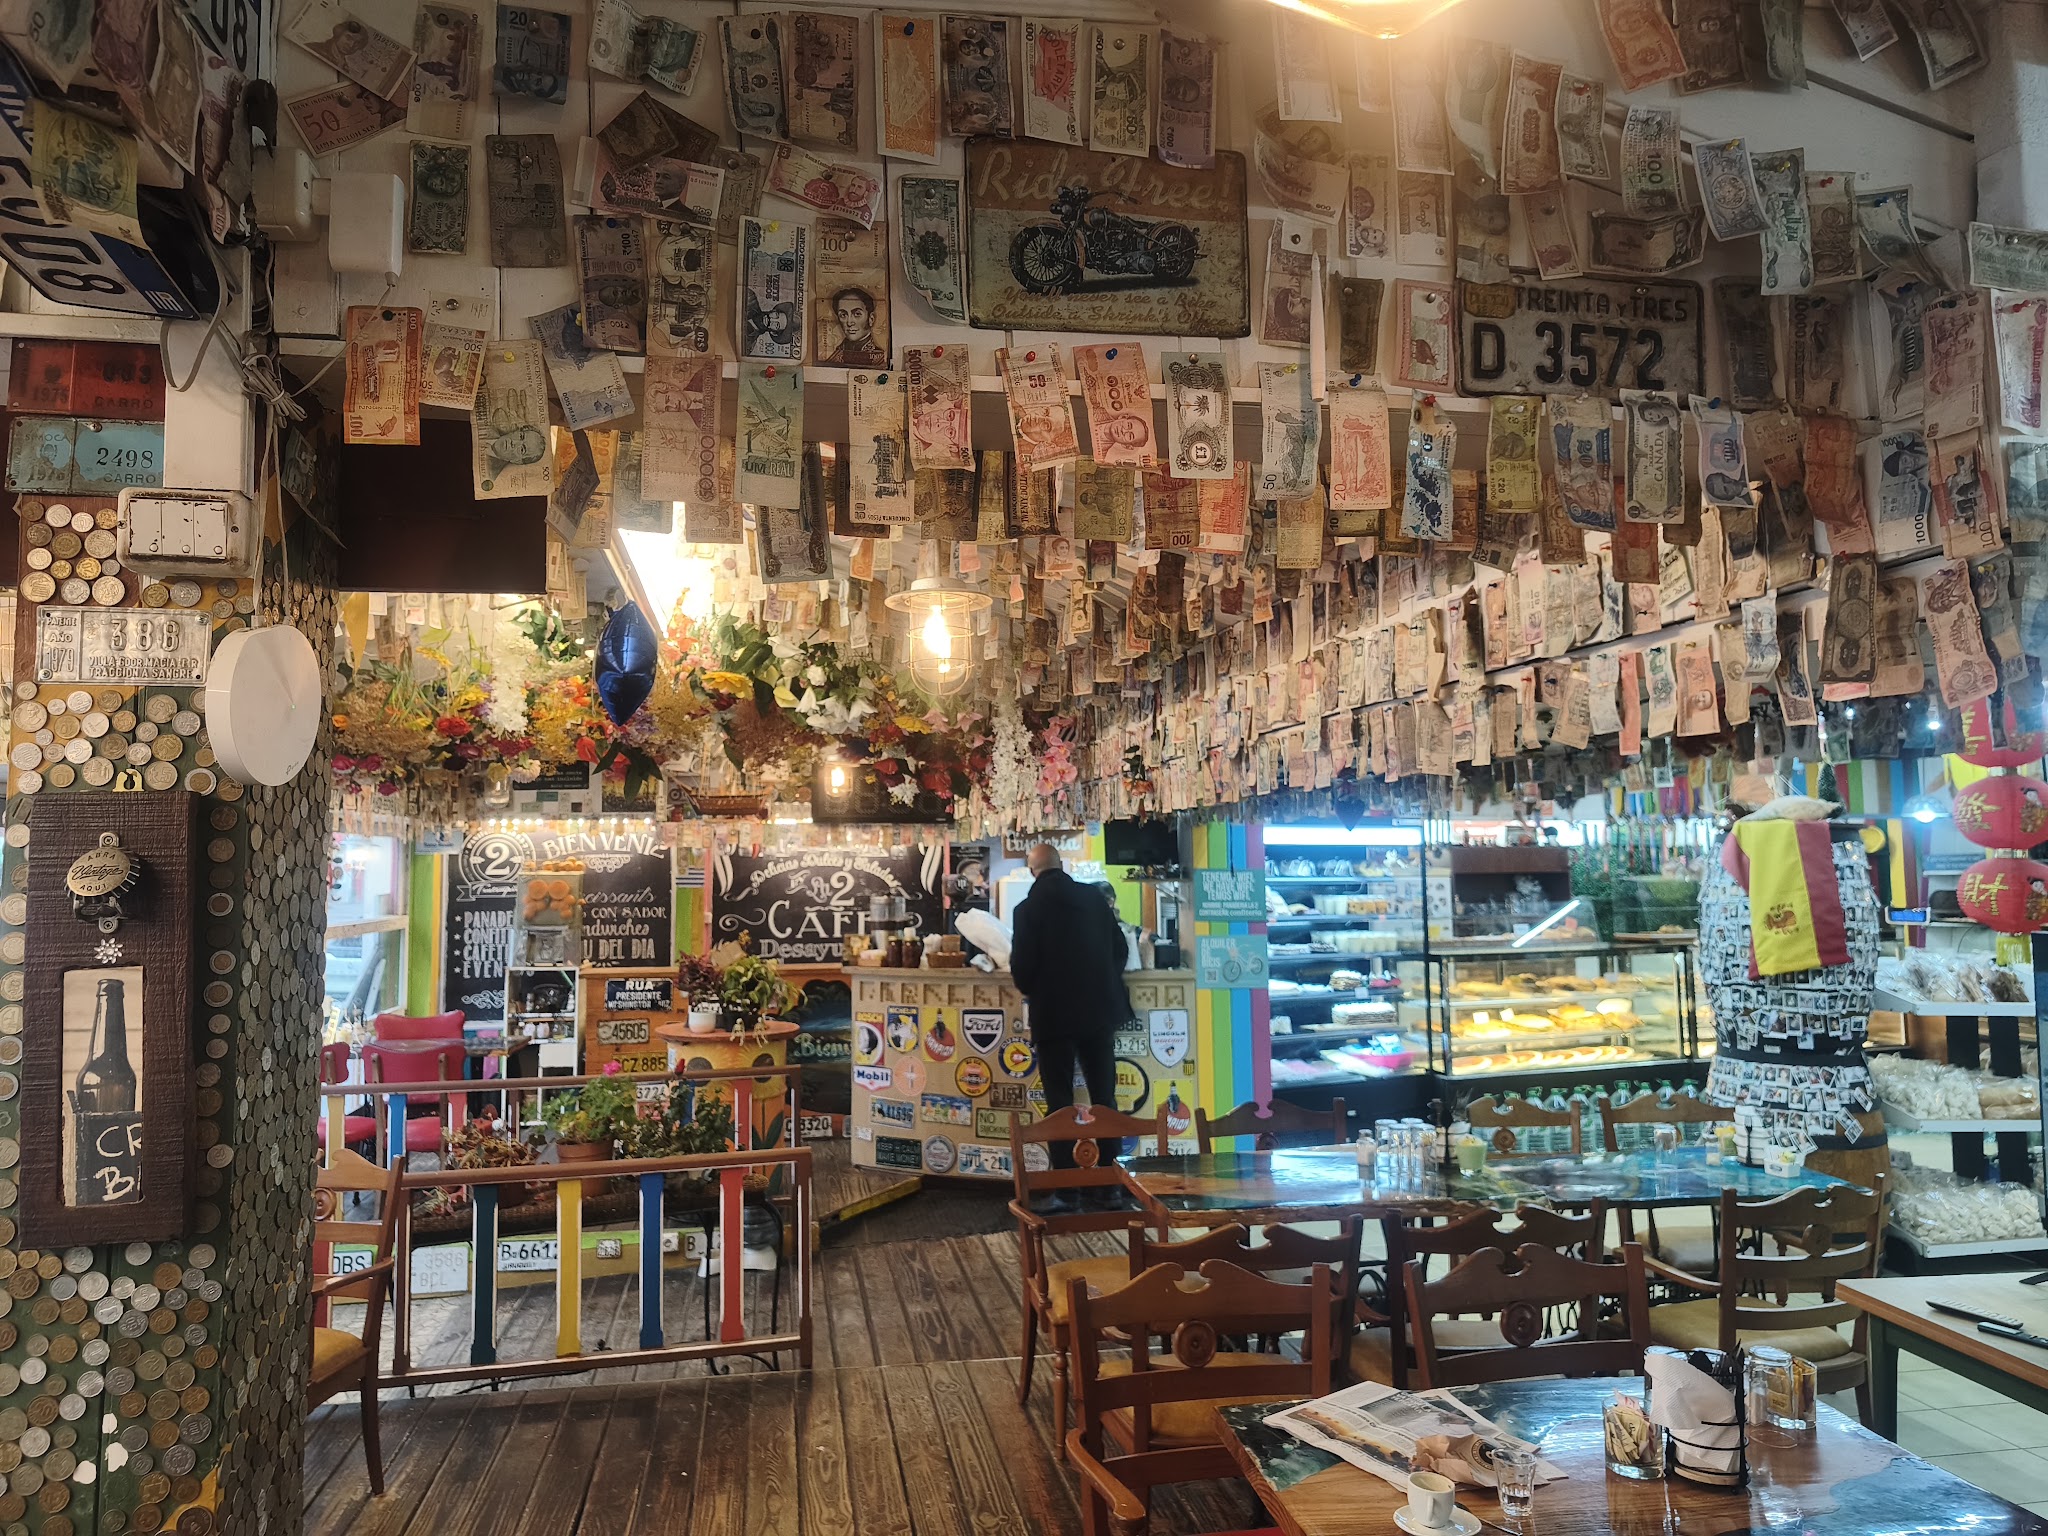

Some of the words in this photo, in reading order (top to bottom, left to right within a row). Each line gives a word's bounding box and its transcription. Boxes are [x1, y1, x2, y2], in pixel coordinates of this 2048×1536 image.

[301, 109, 342, 140] 50
[1647, 151, 1661, 184] 100
[821, 238, 848, 252] 100
[1003, 286, 1064, 303] You'll
[1124, 291, 1155, 303] see
[1157, 294, 1168, 304] a
[991, 304, 1061, 320] Outside
[1515, 287, 1611, 315] TREINTA
[1630, 297, 1688, 322] TRES
[1472, 321, 1506, 380] D
[1534, 321, 1666, 391] 3572
[94, 396, 154, 410] CARRO
[350, 415, 363, 437] 100
[1422, 433, 1433, 452] 50
[1881, 437, 1898, 447] 1000
[96, 447, 154, 469] 2498
[1654, 430, 1664, 482] CANADA
[769, 461, 793, 476] REAL
[103, 472, 156, 484] CARRO
[1020, 470, 1028, 494] DOLLA
[1263, 473, 1277, 490] 50
[1334, 483, 1347, 502] 20
[1020, 497, 1029, 522] TWENTY
[1914, 514, 1926, 543] 1000
[1172, 535, 1192, 547] 100
[46, 616, 77, 627] PATENTE
[109, 618, 181, 652] 388
[49, 631, 73, 643] AÑO
[47, 647, 75, 672] 1979
[89, 656, 116, 668] VILLA
[89, 667, 140, 679] TRACCION
[141, 668, 149, 679] A
[151, 669, 193, 680] SANGRE
[86, 851, 116, 862] ABRA
[484, 843, 511, 876] 2
[844, 857, 853, 872] y
[70, 863, 125, 881] Vintage
[829, 870, 855, 907] 2
[591, 907, 616, 920] CON
[621, 907, 668, 920] SABOR
[600, 939, 626, 961] DEL
[631, 938, 656, 960] DIA
[759, 938, 844, 962] Desayu
[1201, 938, 1236, 949] ALQUILER
[625, 980, 654, 991] RUA
[615, 991, 662, 1001] PRESIDENTE
[611, 1022, 648, 1041] 45605
[965, 1017, 1002, 1031] Ford
[641, 1057, 667, 1073] 885
[857, 1070, 889, 1081] Mobil
[979, 1112, 996, 1124] NO
